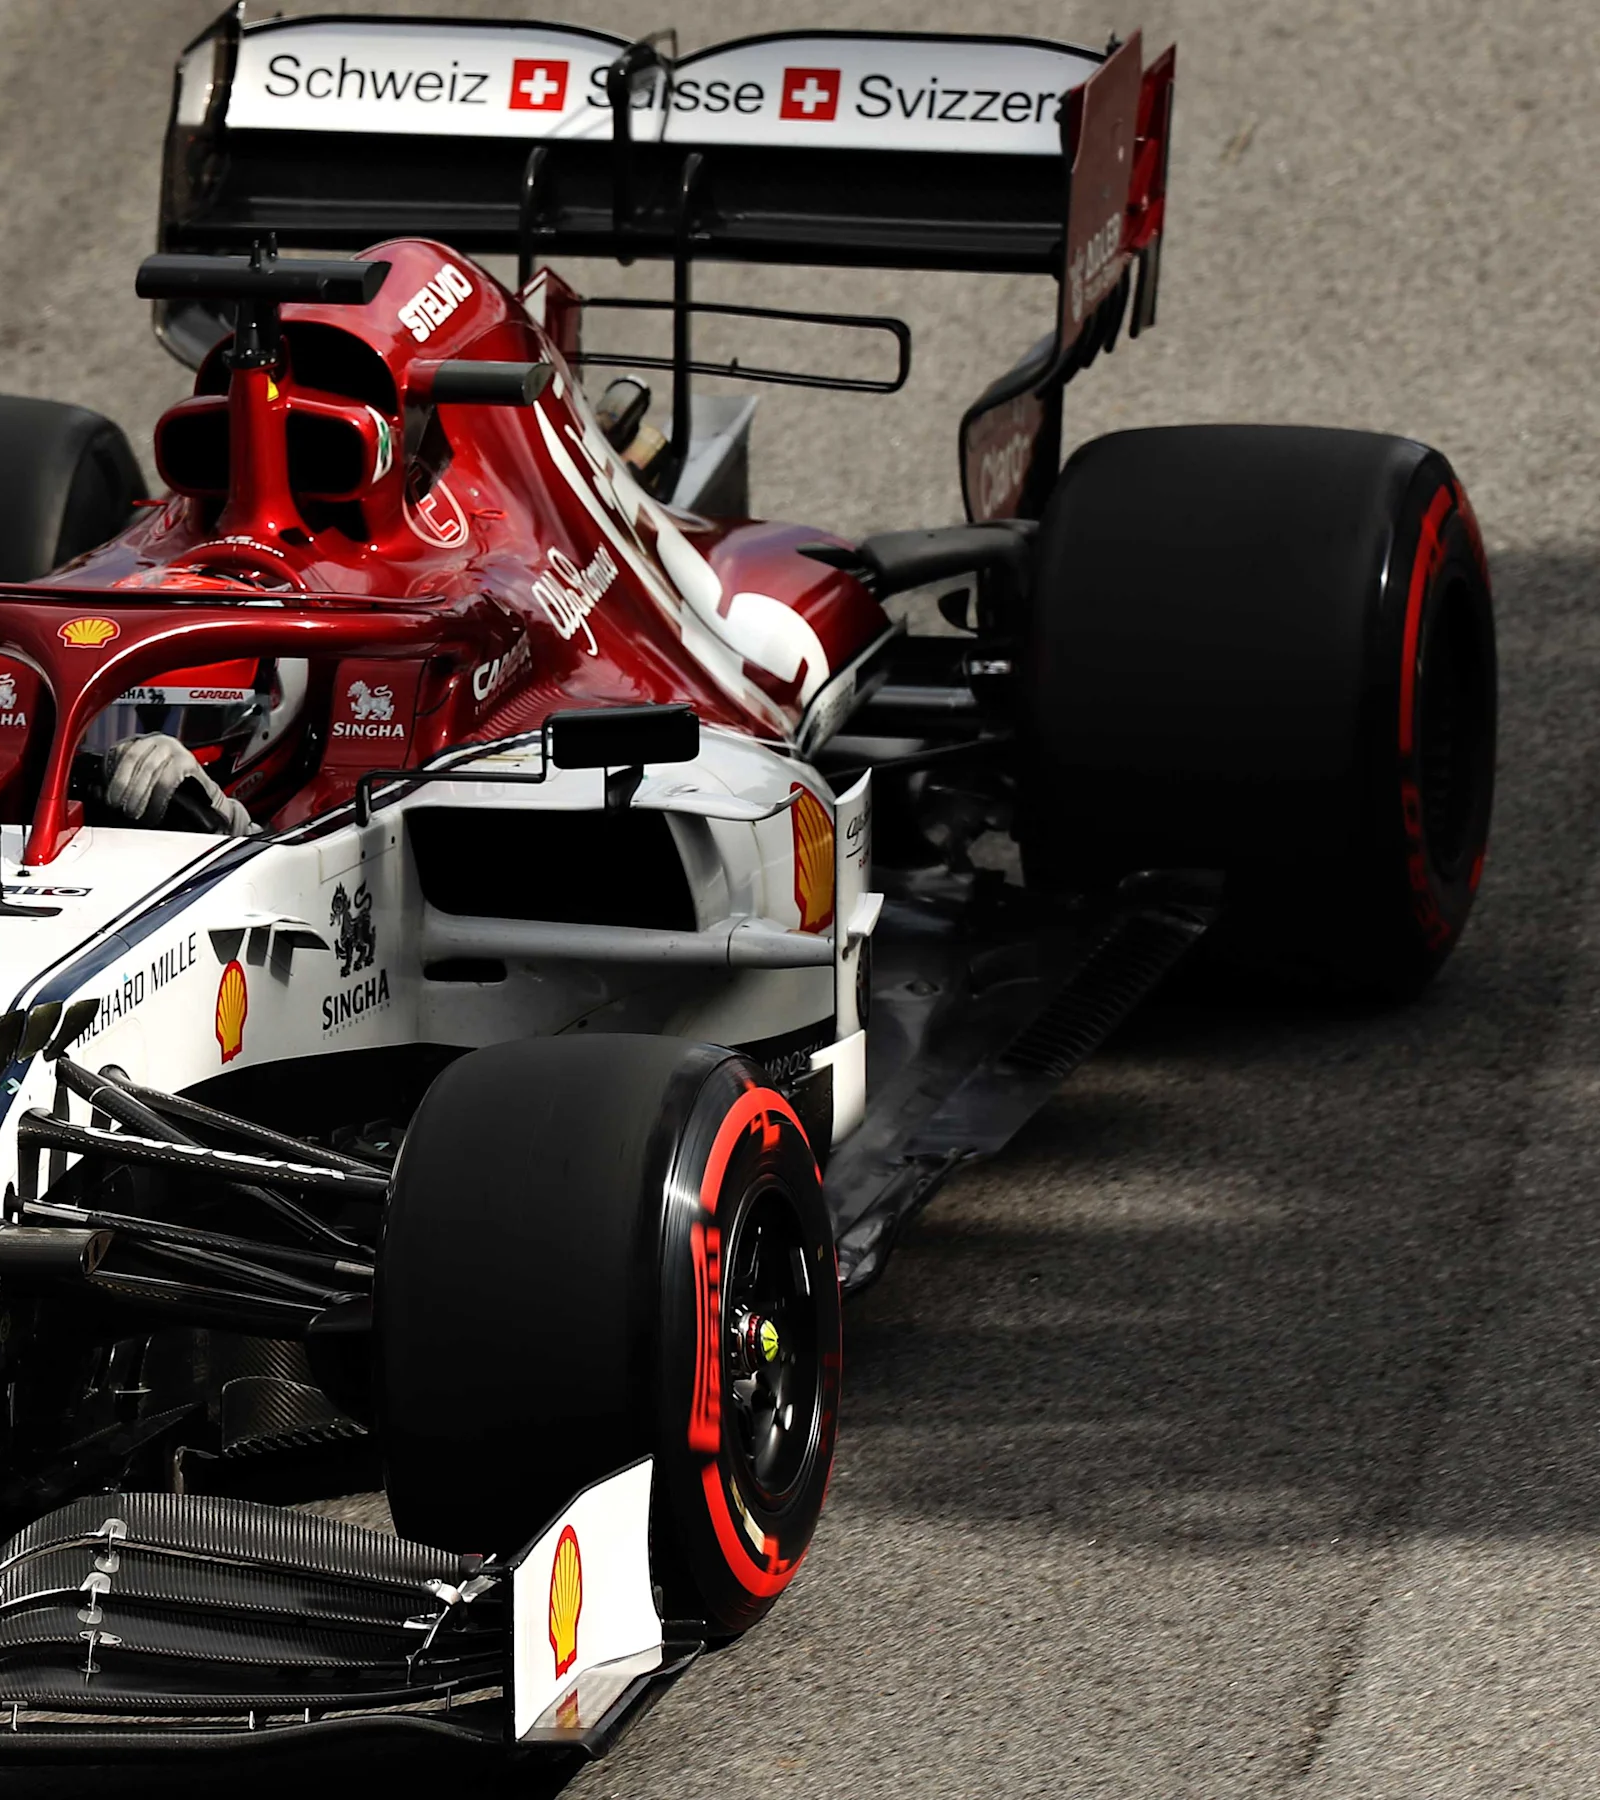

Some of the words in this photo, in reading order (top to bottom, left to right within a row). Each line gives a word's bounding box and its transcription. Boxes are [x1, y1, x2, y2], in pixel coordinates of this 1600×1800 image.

[264, 54, 490, 103] Schweiz
[855, 73, 1062, 123] Svizzer
[397, 263, 474, 343] STELVIO
[189, 689, 244, 700] CARRERA
[332, 721, 405, 738] SINGHA
[150, 931, 197, 995] MILLE
[322, 968, 390, 1031] SINGHA
